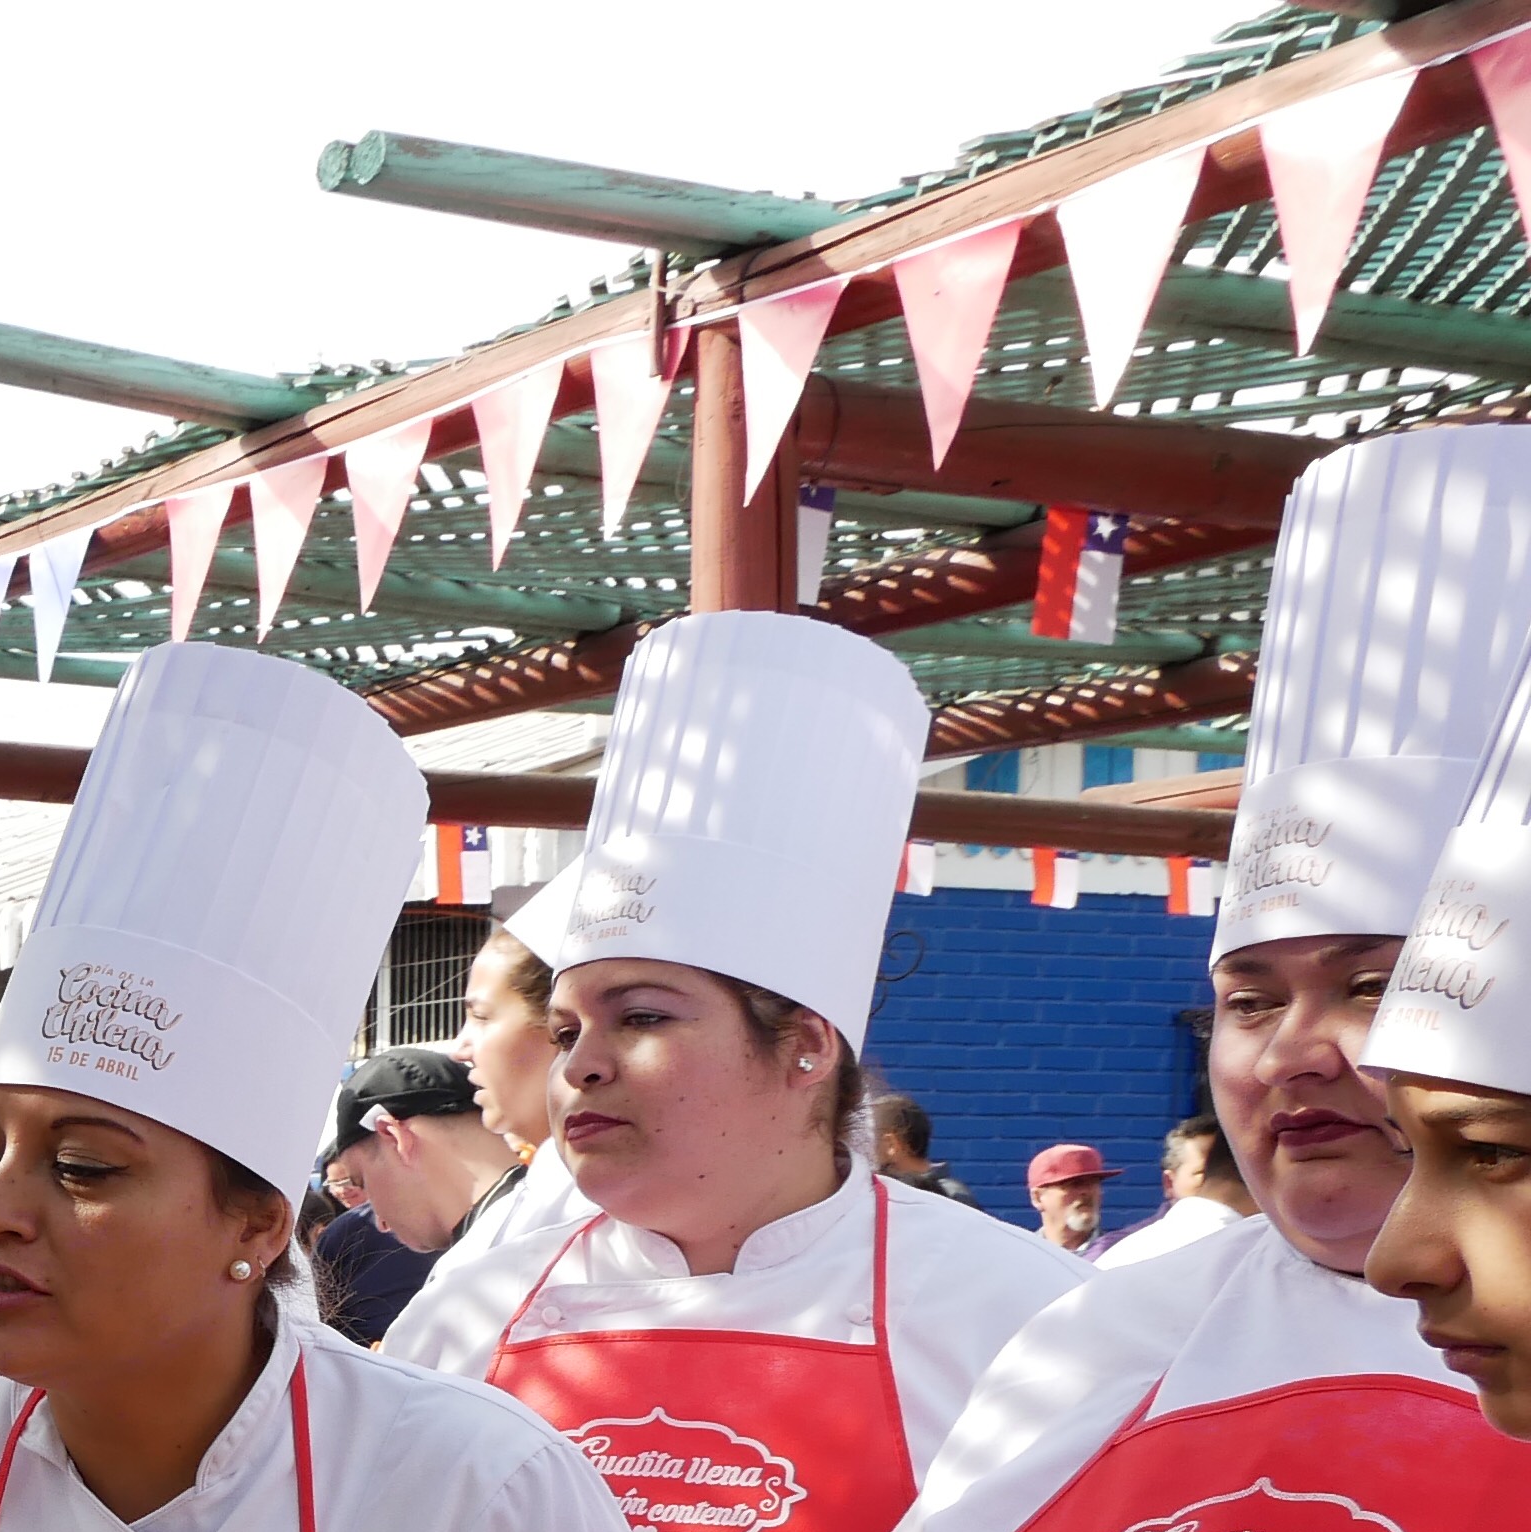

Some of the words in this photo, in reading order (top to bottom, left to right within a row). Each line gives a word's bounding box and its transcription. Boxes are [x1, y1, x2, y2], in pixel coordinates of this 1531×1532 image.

[58, 963, 183, 1031] Cocina
[140, 976, 155, 988] LA
[42, 1000, 176, 1071] Chilena
[47, 1046, 65, 1063] 15
[69, 1051, 90, 1067] DE
[95, 1056, 139, 1081] ABRIL
[684, 1457, 763, 1487] llena
[647, 1500, 757, 1527] contento
